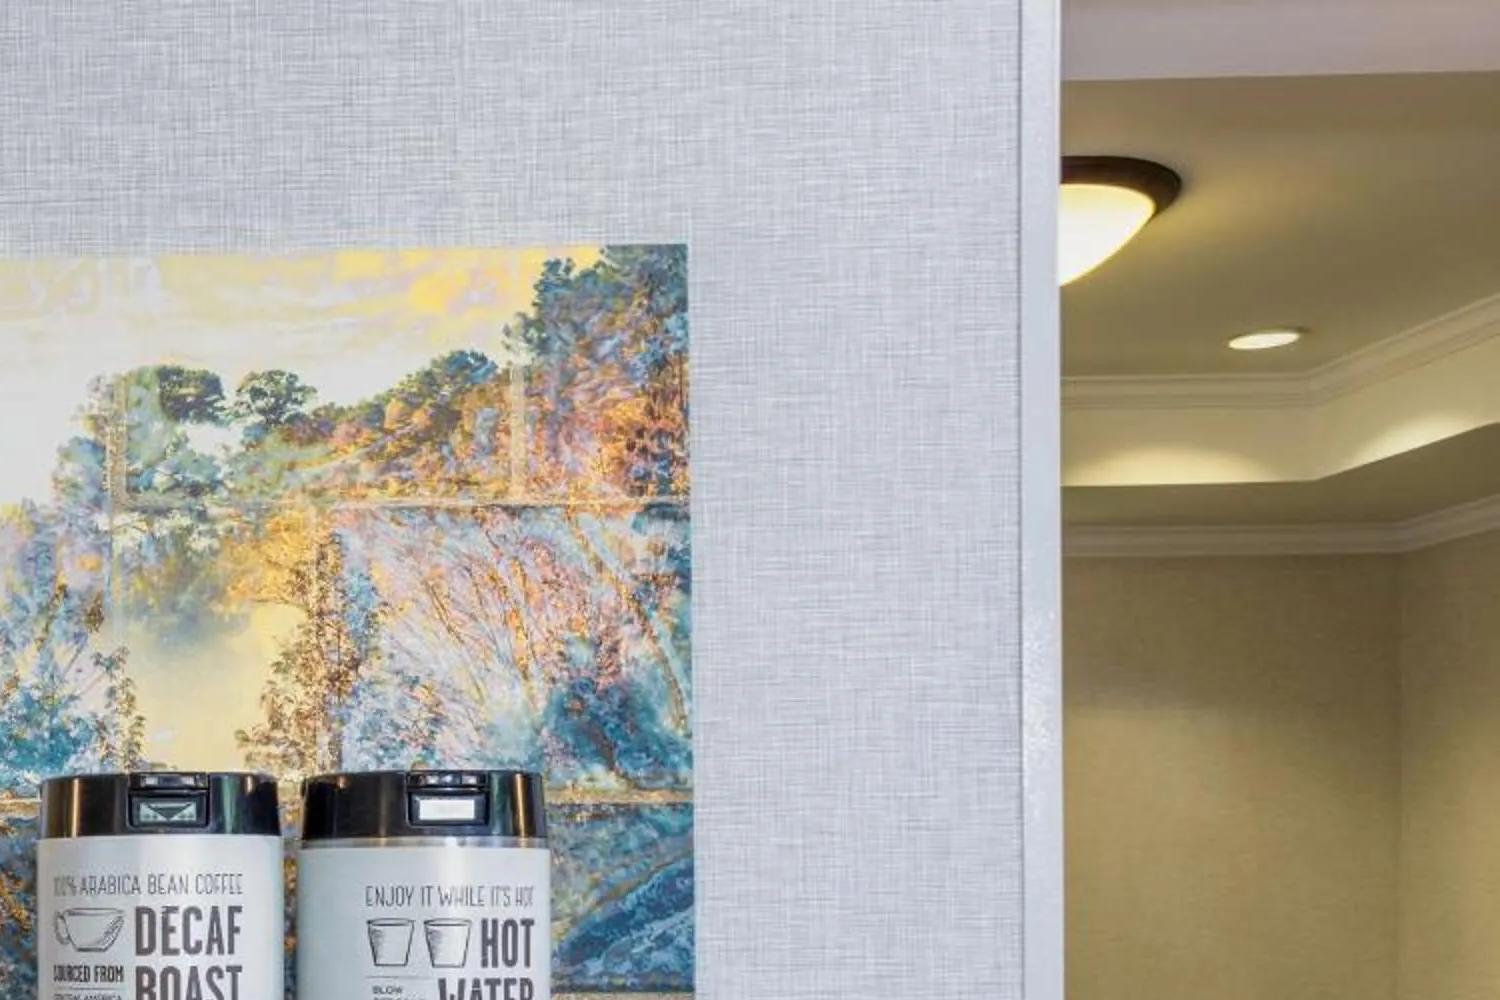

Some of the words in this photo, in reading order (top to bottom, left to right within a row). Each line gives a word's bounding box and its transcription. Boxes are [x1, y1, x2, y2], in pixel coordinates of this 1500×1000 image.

[80, 874, 141, 896] ARABICA
[148, 873, 189, 895] BEAN
[195, 873, 244, 895] COFFEE
[365, 885, 415, 907] ENJOY
[421, 886, 433, 907] IT
[437, 885, 485, 907] WHILE
[135, 905, 244, 956] DECAF
[481, 918, 535, 969] HOT
[93, 965, 125, 983] FROM
[372, 986, 403, 995] BLOW
